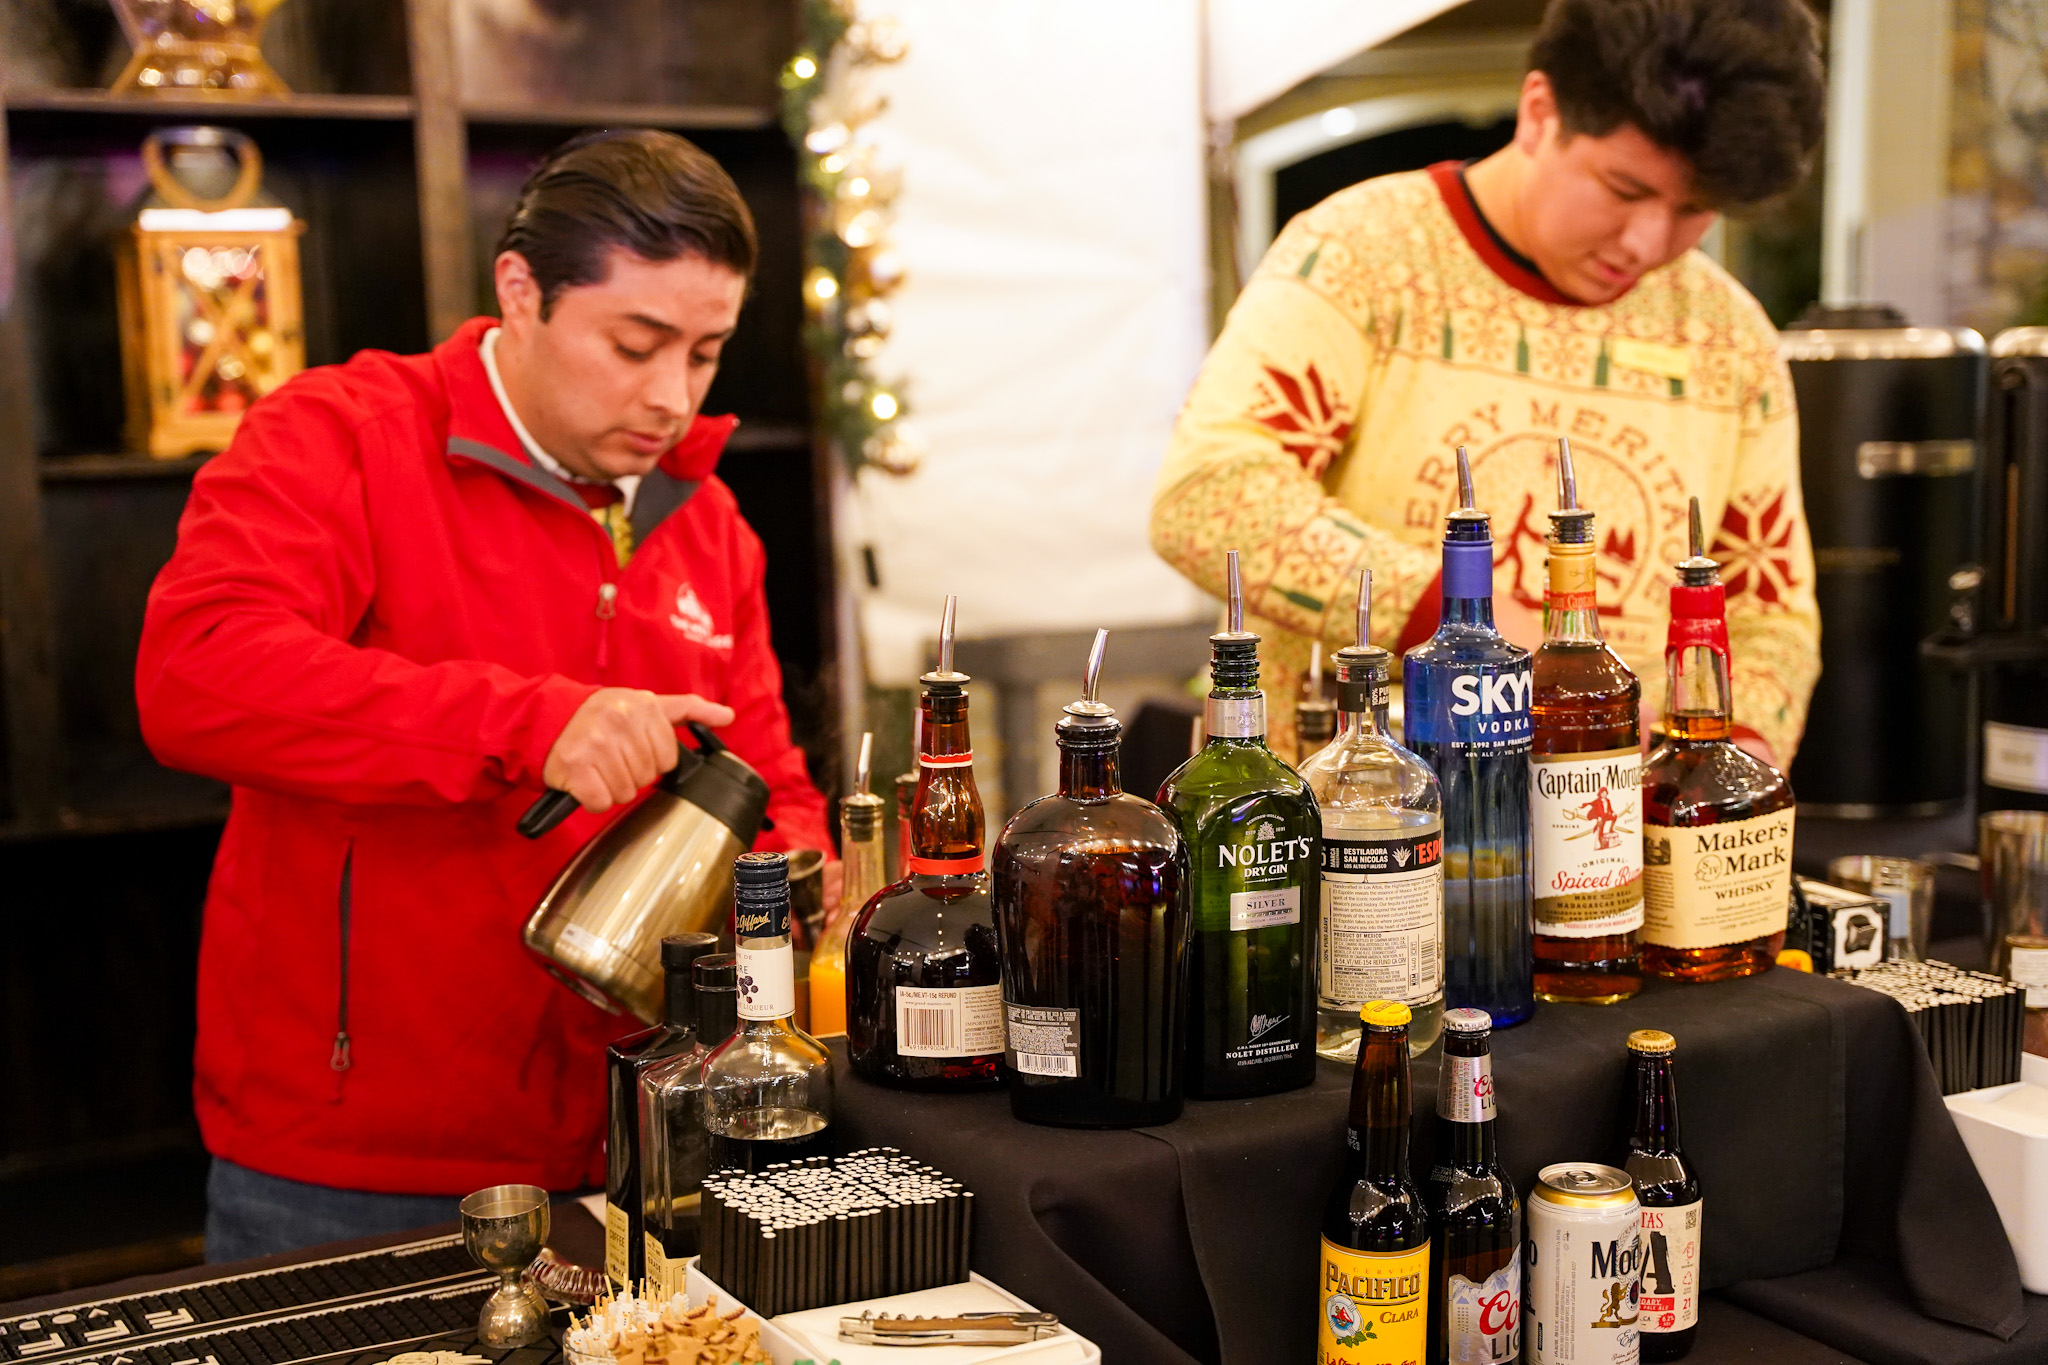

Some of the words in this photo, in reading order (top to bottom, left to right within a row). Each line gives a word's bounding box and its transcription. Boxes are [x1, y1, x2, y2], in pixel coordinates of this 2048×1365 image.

[1406, 403, 1502, 531] ERRY
[1478, 717, 1529, 733] VODKA
[1537, 767, 1600, 799] Captain
[1695, 820, 1788, 853] Maker's
[1724, 846, 1786, 876] Mark
[1244, 866, 1267, 877] DRY
[1269, 864, 1288, 875] GIN
[1552, 870, 1610, 892] Spiced
[1715, 879, 1775, 900] WHISKY
[1246, 898, 1285, 910] SILVER
[1226, 1051, 1253, 1059] NOLET
[1256, 1043, 1300, 1056] DISTILLERY
[610, 1230, 625, 1248] COFFEE
[648, 1256, 661, 1272] GRADE
[1326, 1259, 1421, 1300] PACIFICO
[1683, 1298, 1690, 1310] 21
[1379, 1308, 1419, 1324] CLARA
